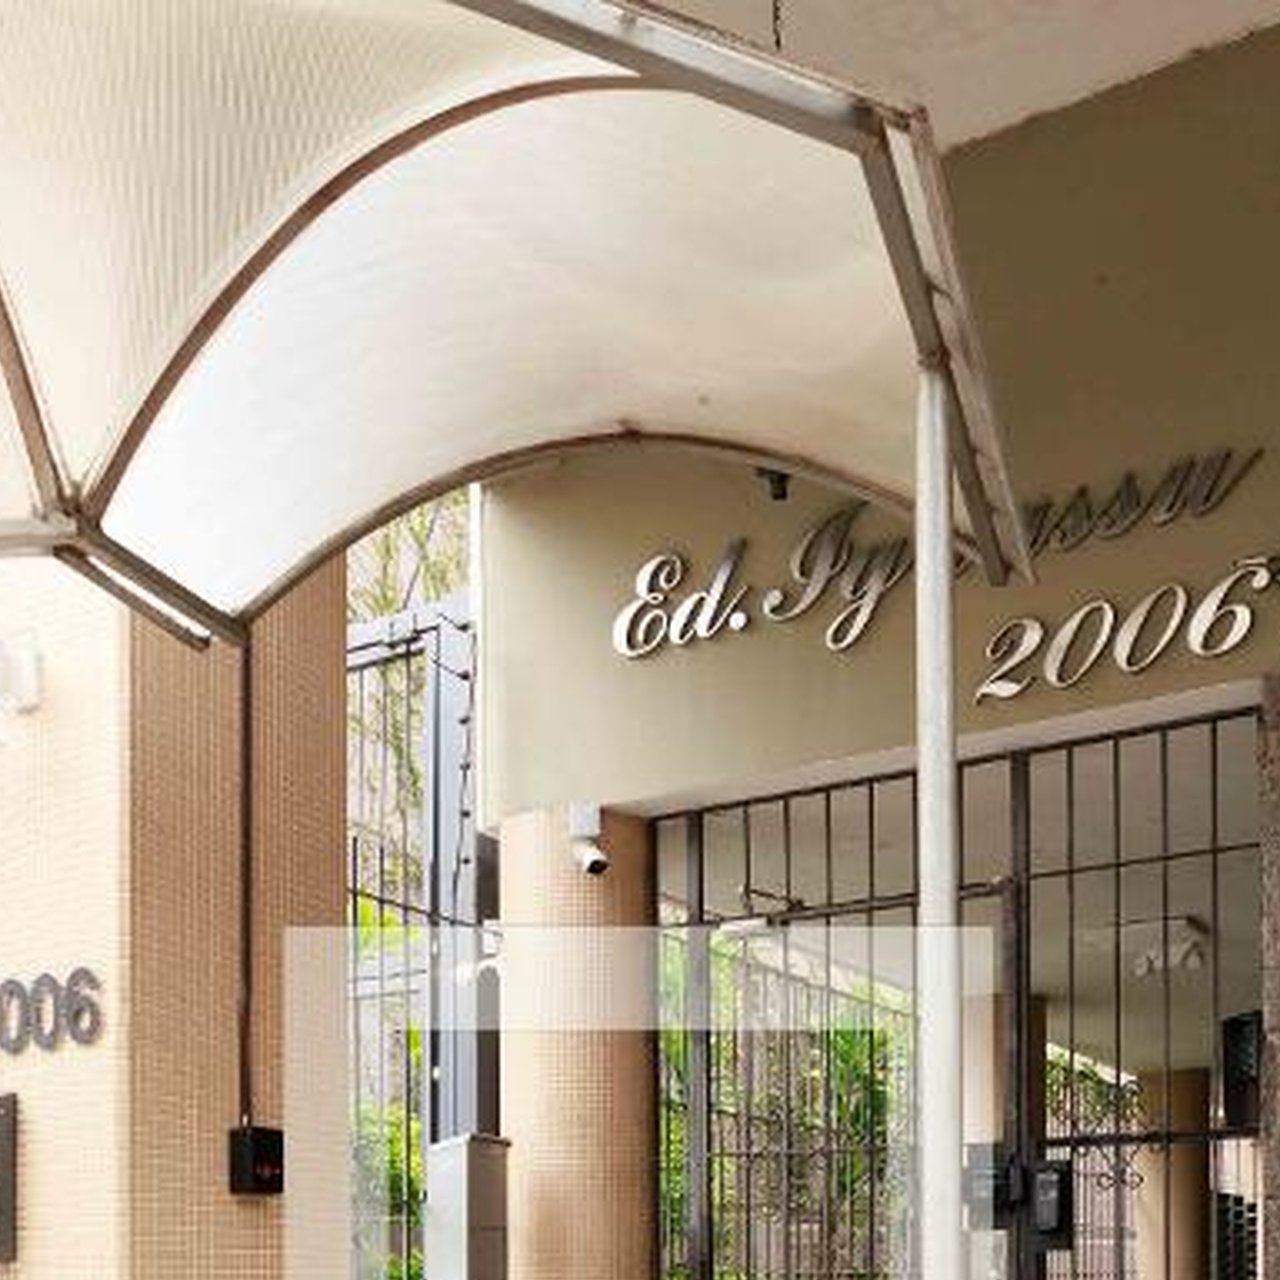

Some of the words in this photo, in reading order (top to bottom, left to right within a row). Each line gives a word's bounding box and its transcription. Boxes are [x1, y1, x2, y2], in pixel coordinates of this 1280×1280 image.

[612, 537, 750, 657] Ed.
[762, 447, 1266, 651] Igssu
[976, 561, 1271, 704] 2006
